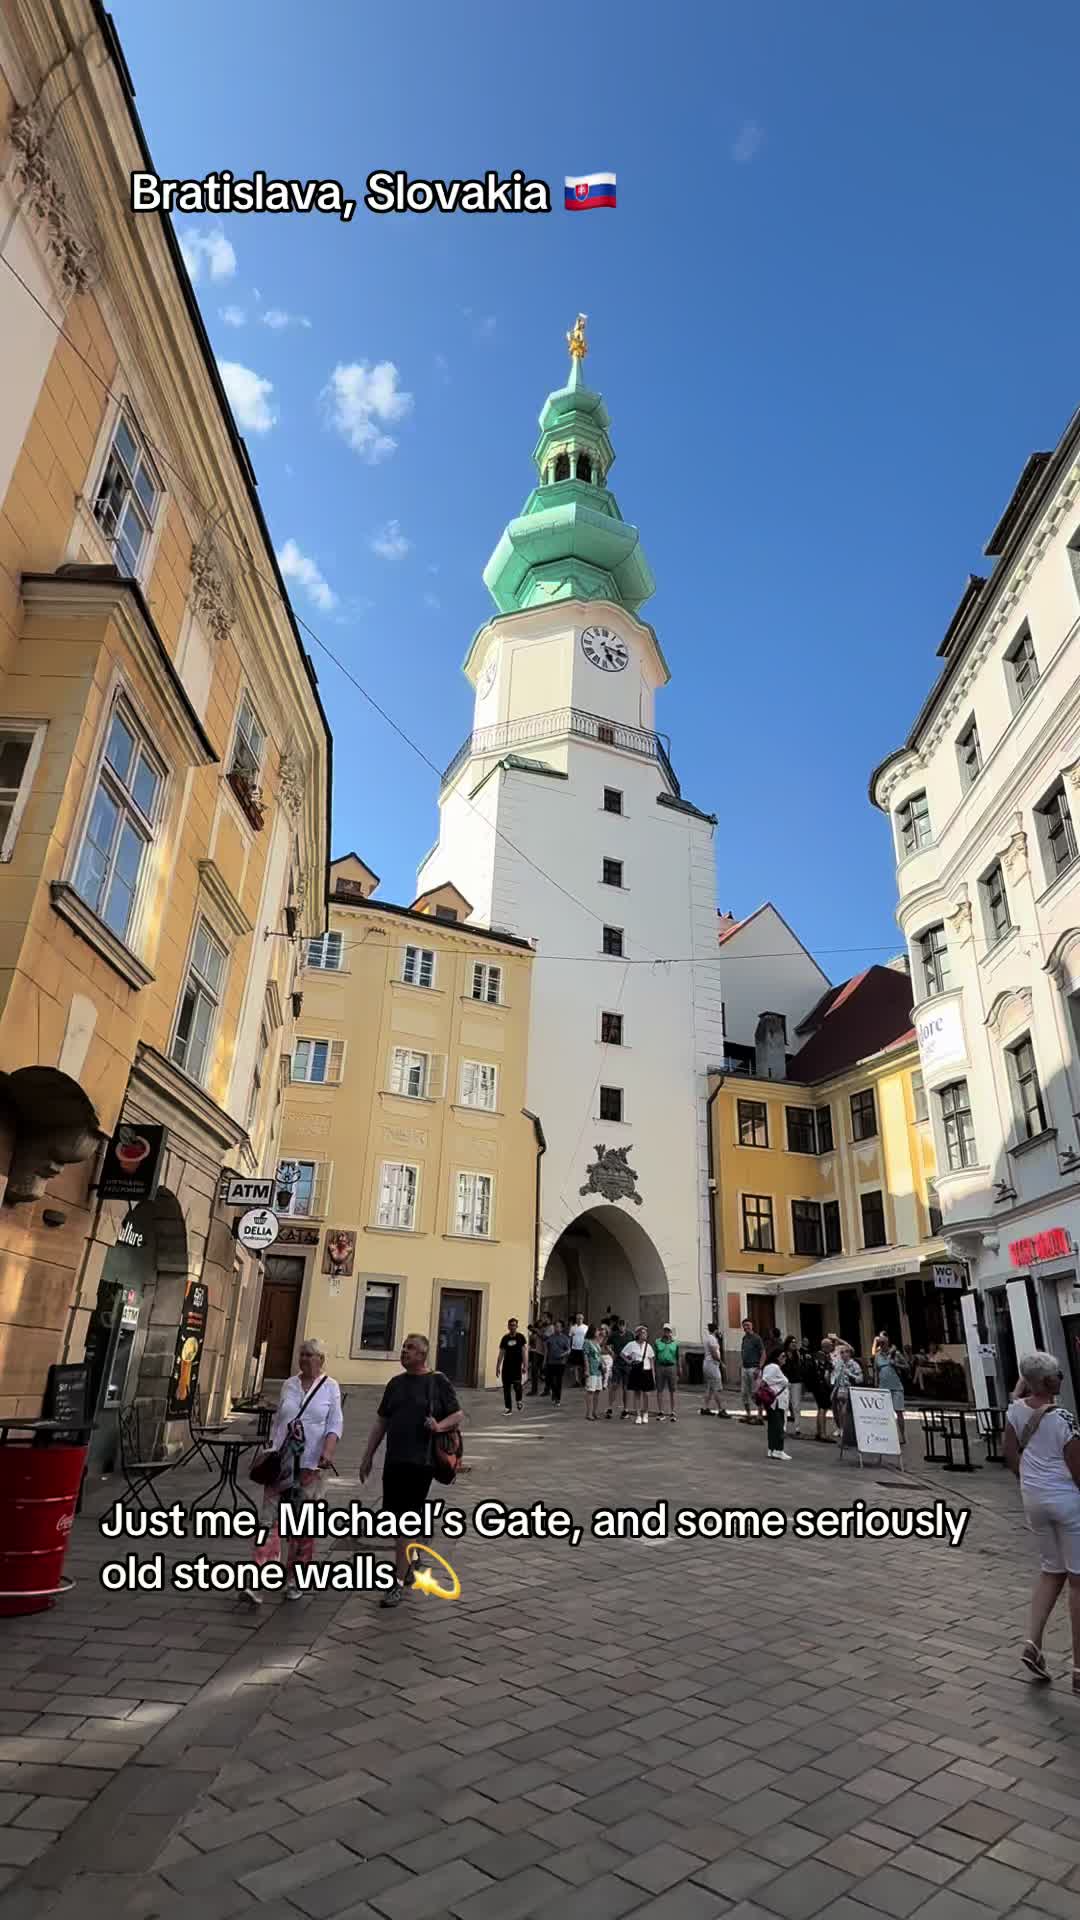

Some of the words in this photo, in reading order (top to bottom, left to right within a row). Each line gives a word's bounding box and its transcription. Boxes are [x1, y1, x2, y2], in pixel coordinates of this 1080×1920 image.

[232, 1184, 270, 1199] ATM
[244, 1226, 272, 1236] DELIA
[935, 1267, 953, 1277] WC
[859, 1396, 885, 1410] WC
